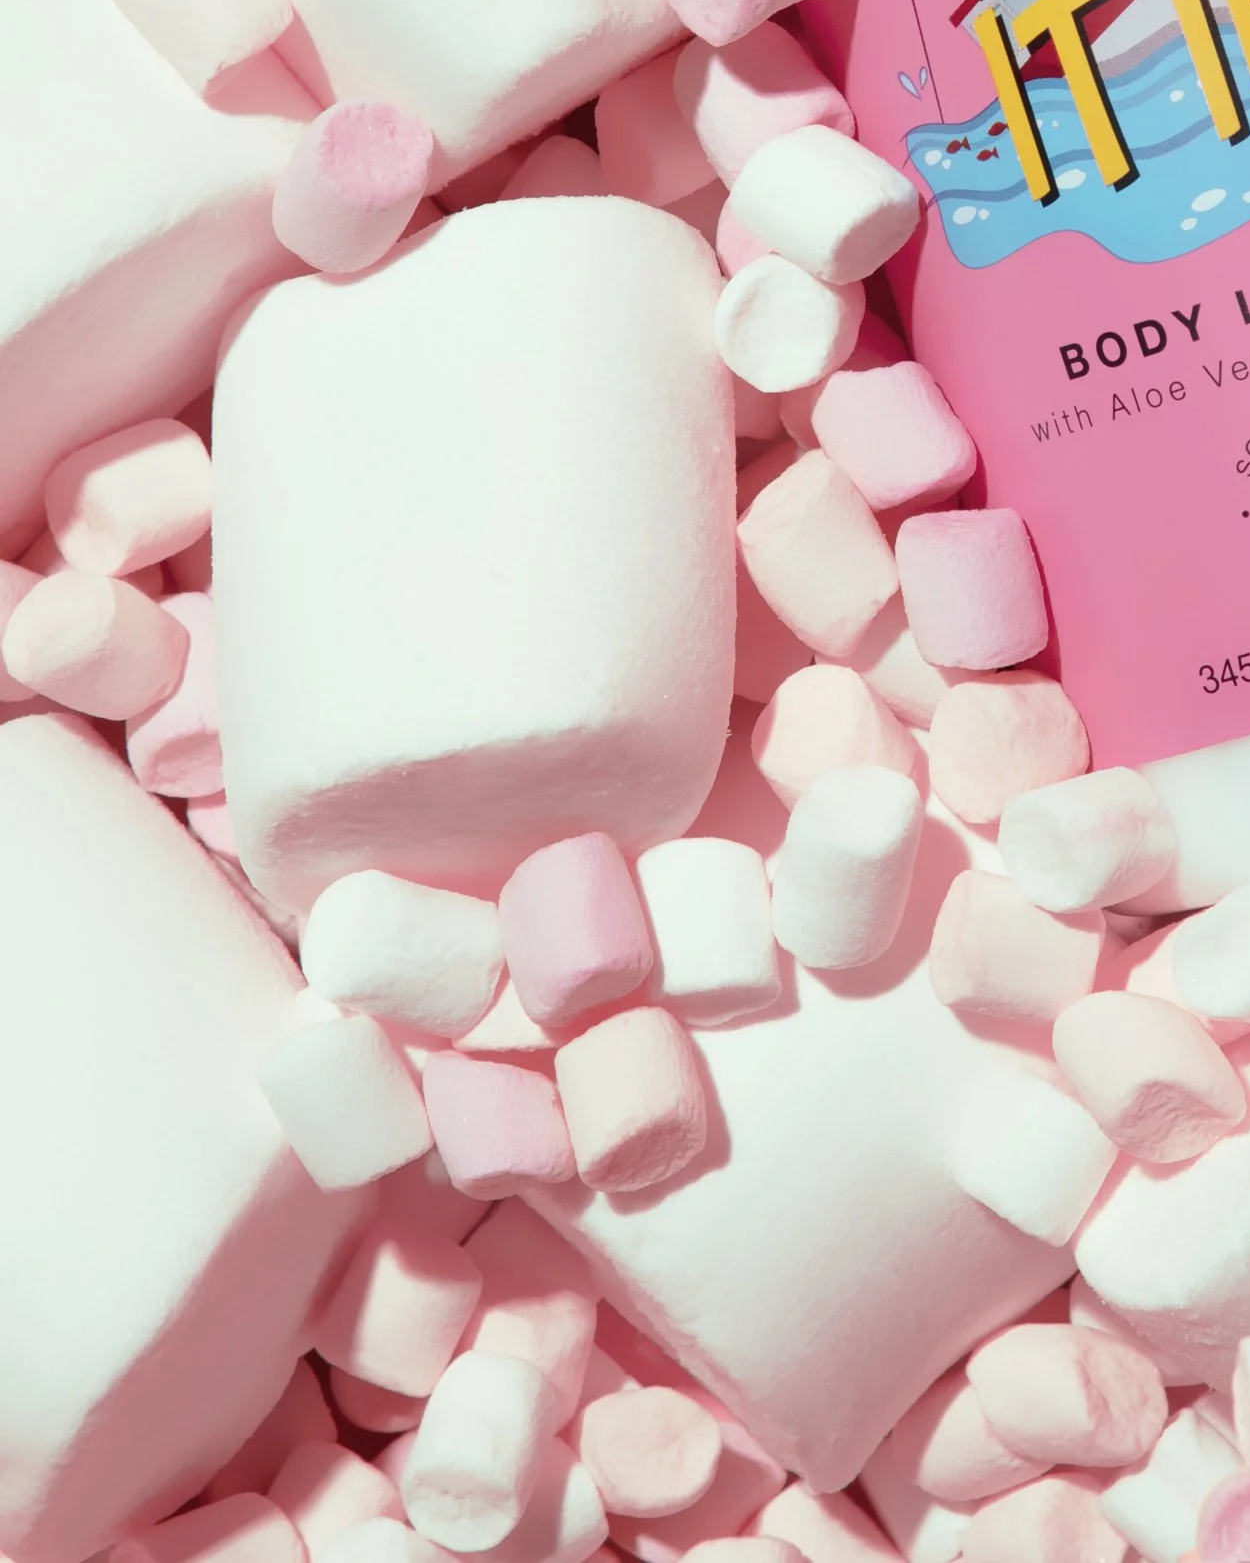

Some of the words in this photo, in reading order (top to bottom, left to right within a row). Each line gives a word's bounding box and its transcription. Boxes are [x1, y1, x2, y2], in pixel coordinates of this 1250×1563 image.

[1059, 303, 1203, 380] BODY
[1030, 404, 1093, 443] with
[1110, 381, 1187, 421] Aloe
